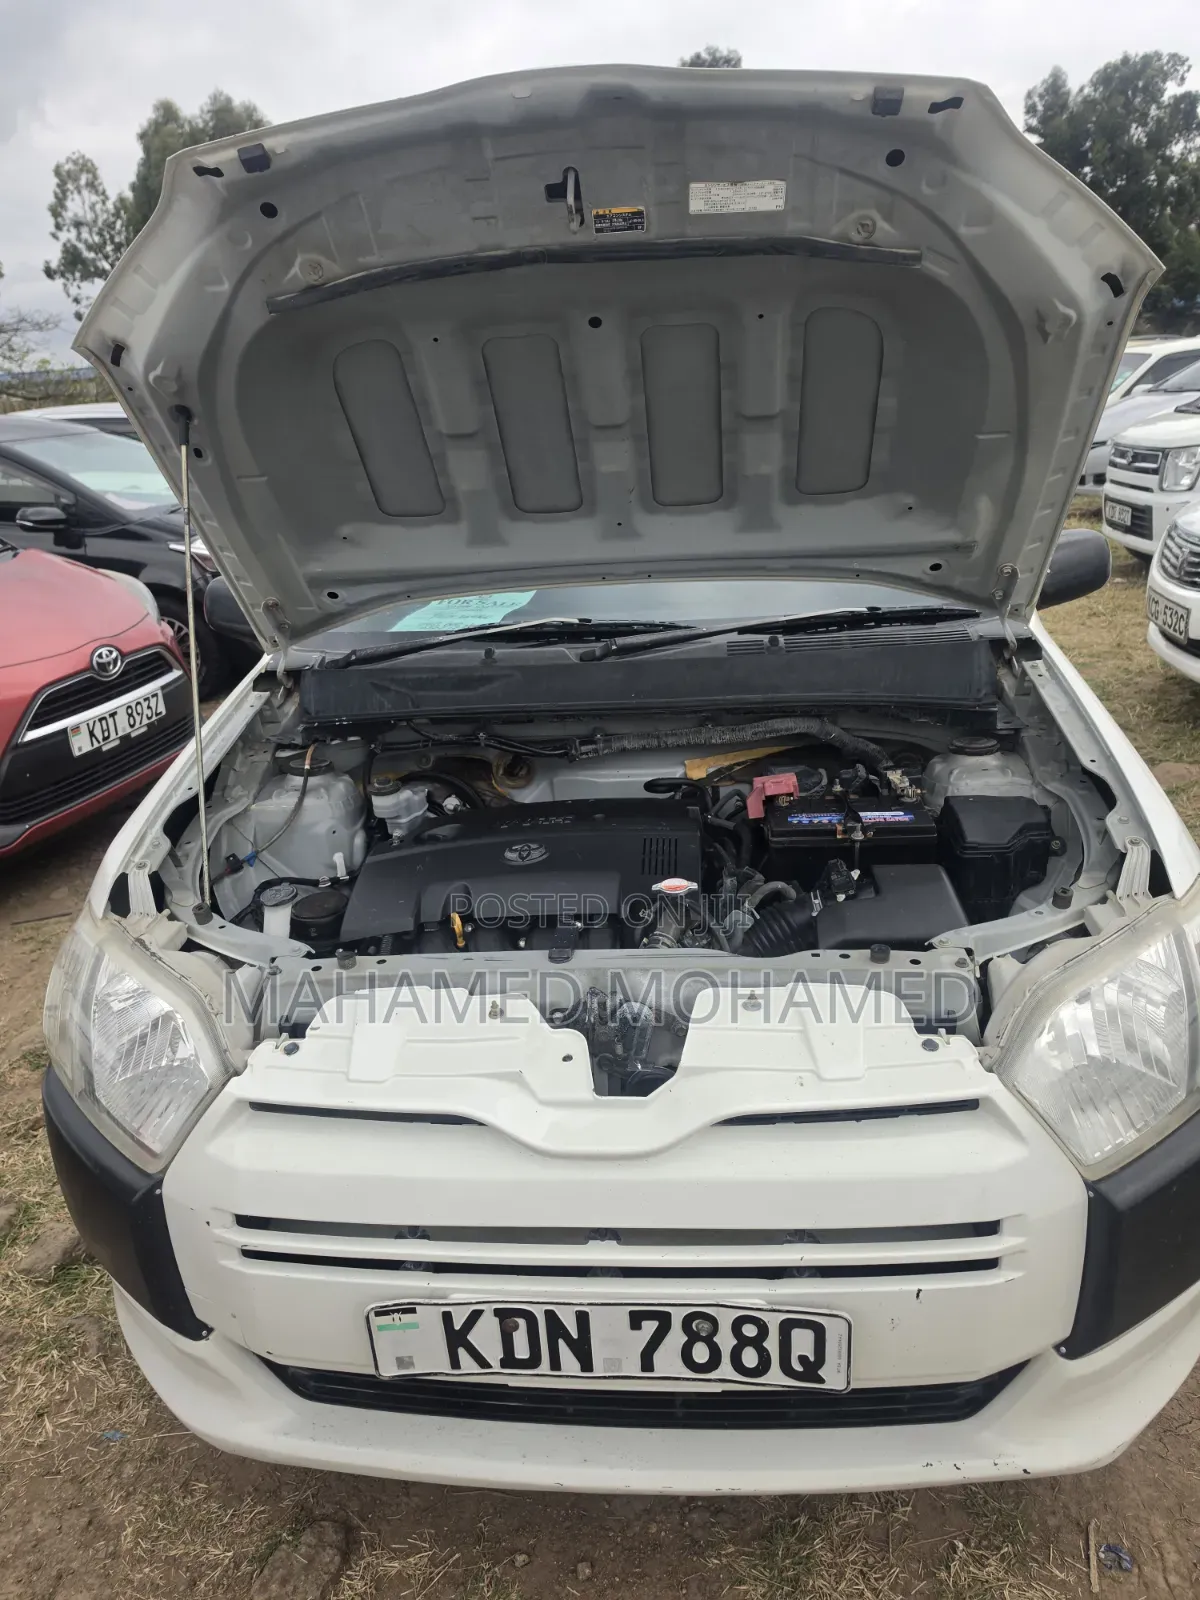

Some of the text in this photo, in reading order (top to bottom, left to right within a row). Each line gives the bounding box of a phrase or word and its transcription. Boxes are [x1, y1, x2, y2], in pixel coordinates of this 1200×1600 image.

[1162, 604, 1185, 636] 532C
[86, 692, 163, 748] KDT 893Z
[441, 1306, 595, 1373] KDN
[628, 1309, 828, 1385] 788Q
